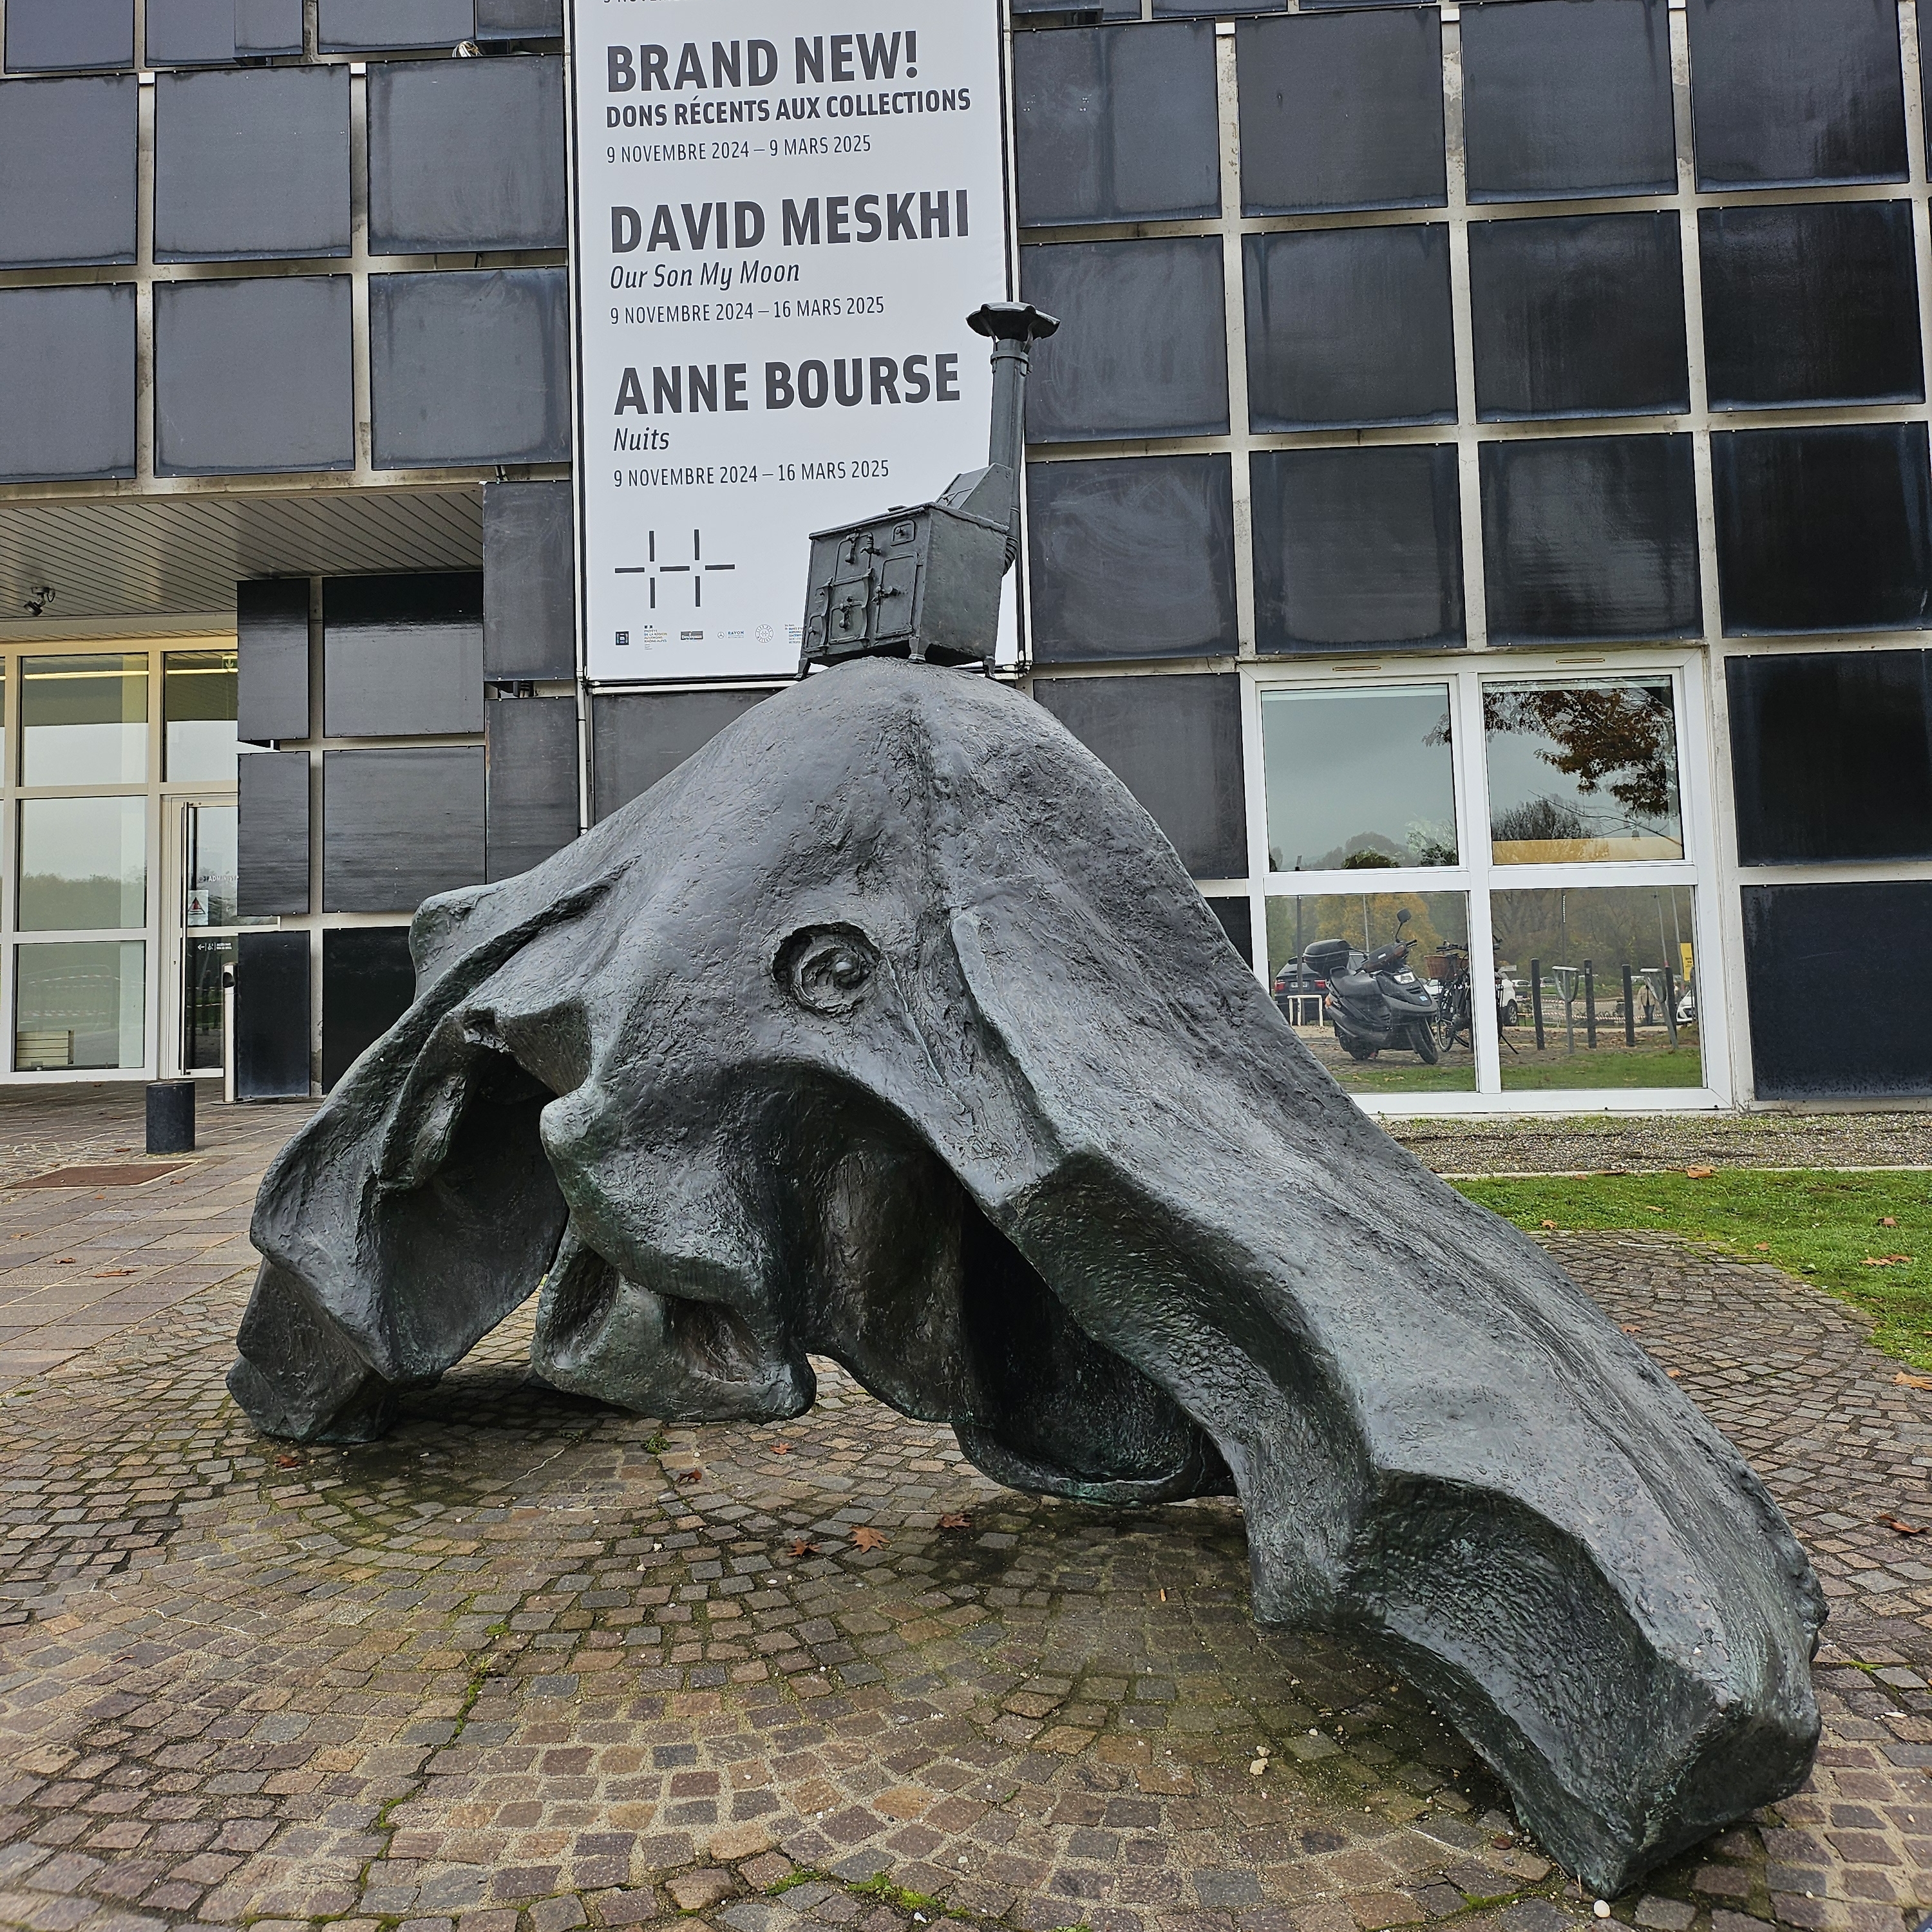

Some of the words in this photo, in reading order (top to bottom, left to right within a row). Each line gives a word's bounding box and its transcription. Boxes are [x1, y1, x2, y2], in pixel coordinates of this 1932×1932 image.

[607, 39, 779, 93] BRAND
[795, 30, 918, 84] NEW!
[606, 104, 667, 128] DONS
[674, 95, 771, 126] RÉCENTS
[775, 97, 821, 121] AUX
[826, 88, 971, 118] COLLECTIONS
[607, 146, 615, 164] 9
[621, 142, 706, 163] NOVEMBRE
[712, 140, 750, 159] 2024
[770, 139, 778, 156] 9
[784, 137, 828, 156] MARS
[833, 135, 871, 154] 2025
[611, 201, 765, 254] DAVID
[782, 189, 969, 247] MESKHI
[611, 265, 649, 289] Our
[653, 263, 692, 288] Son
[700, 261, 733, 291] My
[740, 260, 799, 285] Moon
[611, 307, 619, 325] 9
[625, 303, 710, 324] NOVEMBRE
[715, 301, 753, 321] 2024
[773, 300, 791, 318] 16
[797, 298, 841, 317] MARS
[846, 296, 884, 315] 2025
[614, 363, 748, 415] ANNE
[765, 353, 960, 410] BOURSE
[613, 426, 670, 451] Nuits
[614, 469, 622, 488] 9
[629, 467, 714, 487] NOVEMBRE
[719, 465, 758, 484] 2024
[778, 464, 795, 481] 16
[801, 462, 846, 481] MARS
[851, 459, 889, 478] 2025
